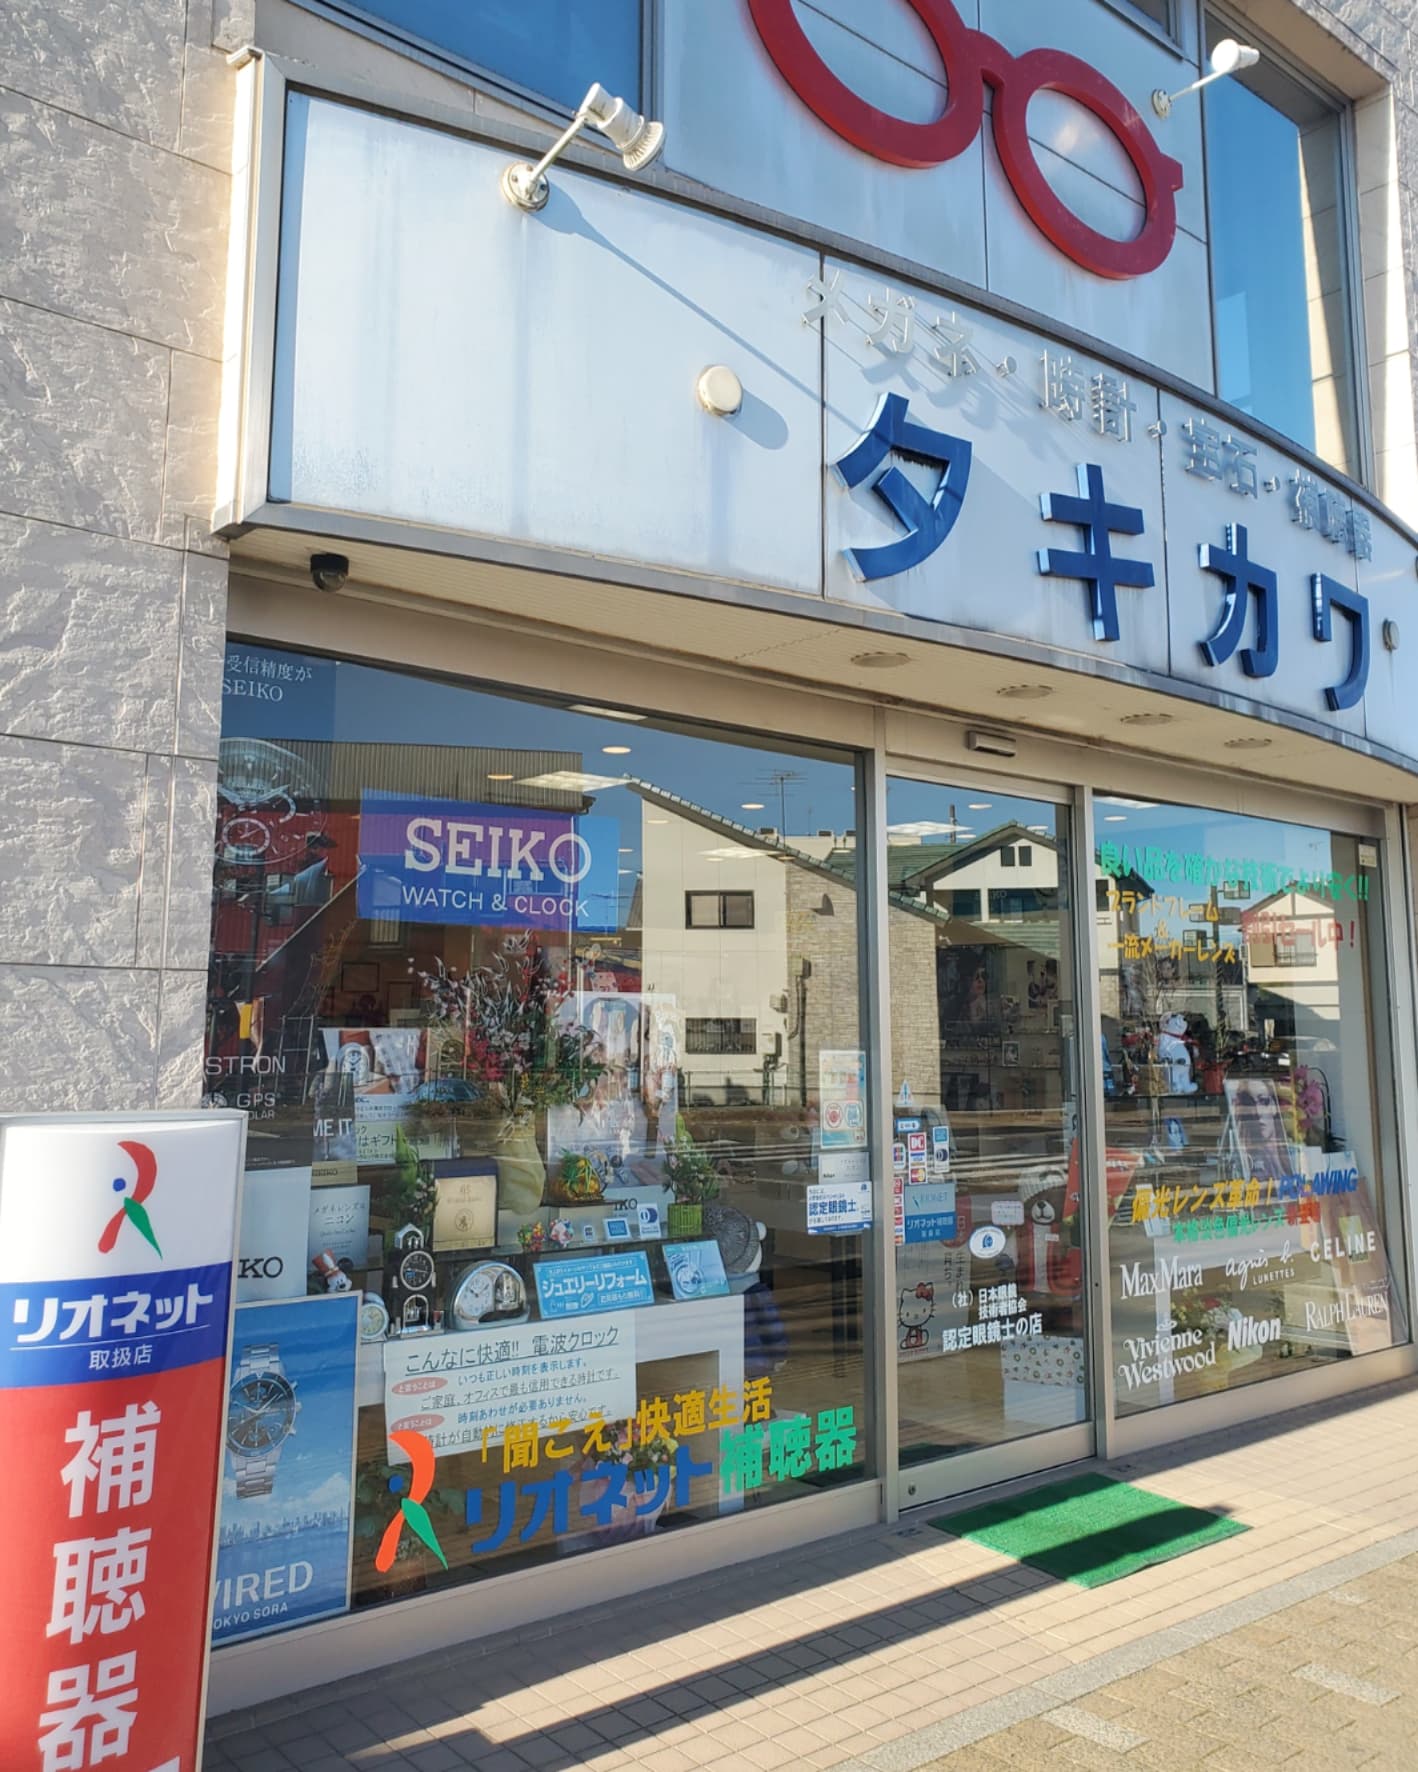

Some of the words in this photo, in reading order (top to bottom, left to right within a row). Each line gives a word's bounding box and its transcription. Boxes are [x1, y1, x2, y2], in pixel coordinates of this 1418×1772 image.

[830, 392, 1370, 711] タキカワ
[227, 655, 312, 682] 受信精度が
[223, 679, 284, 702] SEIKO
[405, 817, 592, 883] SEIKO
[402, 886, 483, 911] WATCH
[491, 893, 508, 912] &
[514, 895, 590, 918] CLOCK
[236, 1092, 276, 1108] GPS
[1310, 1231, 1376, 1263] CELINE
[542, 1268, 648, 1299] ジュエリーリフォーム
[1120, 1255, 1203, 1299] MaxMara
[1253, 1268, 1296, 1286] LUNETTES
[13, 1283, 213, 1343] リオネット
[1306, 1300, 1344, 1331] RALPH
[532, 1326, 619, 1355] 電波クロック
[943, 1313, 1042, 1352] 認定眼鏡士の店
[1123, 1328, 1203, 1362] Vivienne
[1228, 1316, 1282, 1350] Nikon
[89, 1344, 153, 1370] 取扱店
[1119, 1345, 1216, 1391] Westwood
[481, 1376, 772, 1473] 「聞こえ」快適生活
[466, 1446, 712, 1553] リオネット
[719, 1406, 857, 1494] 補聴器
[38, 1400, 161, 1771] 補聴器
[253, 1602, 288, 1620] SORA
